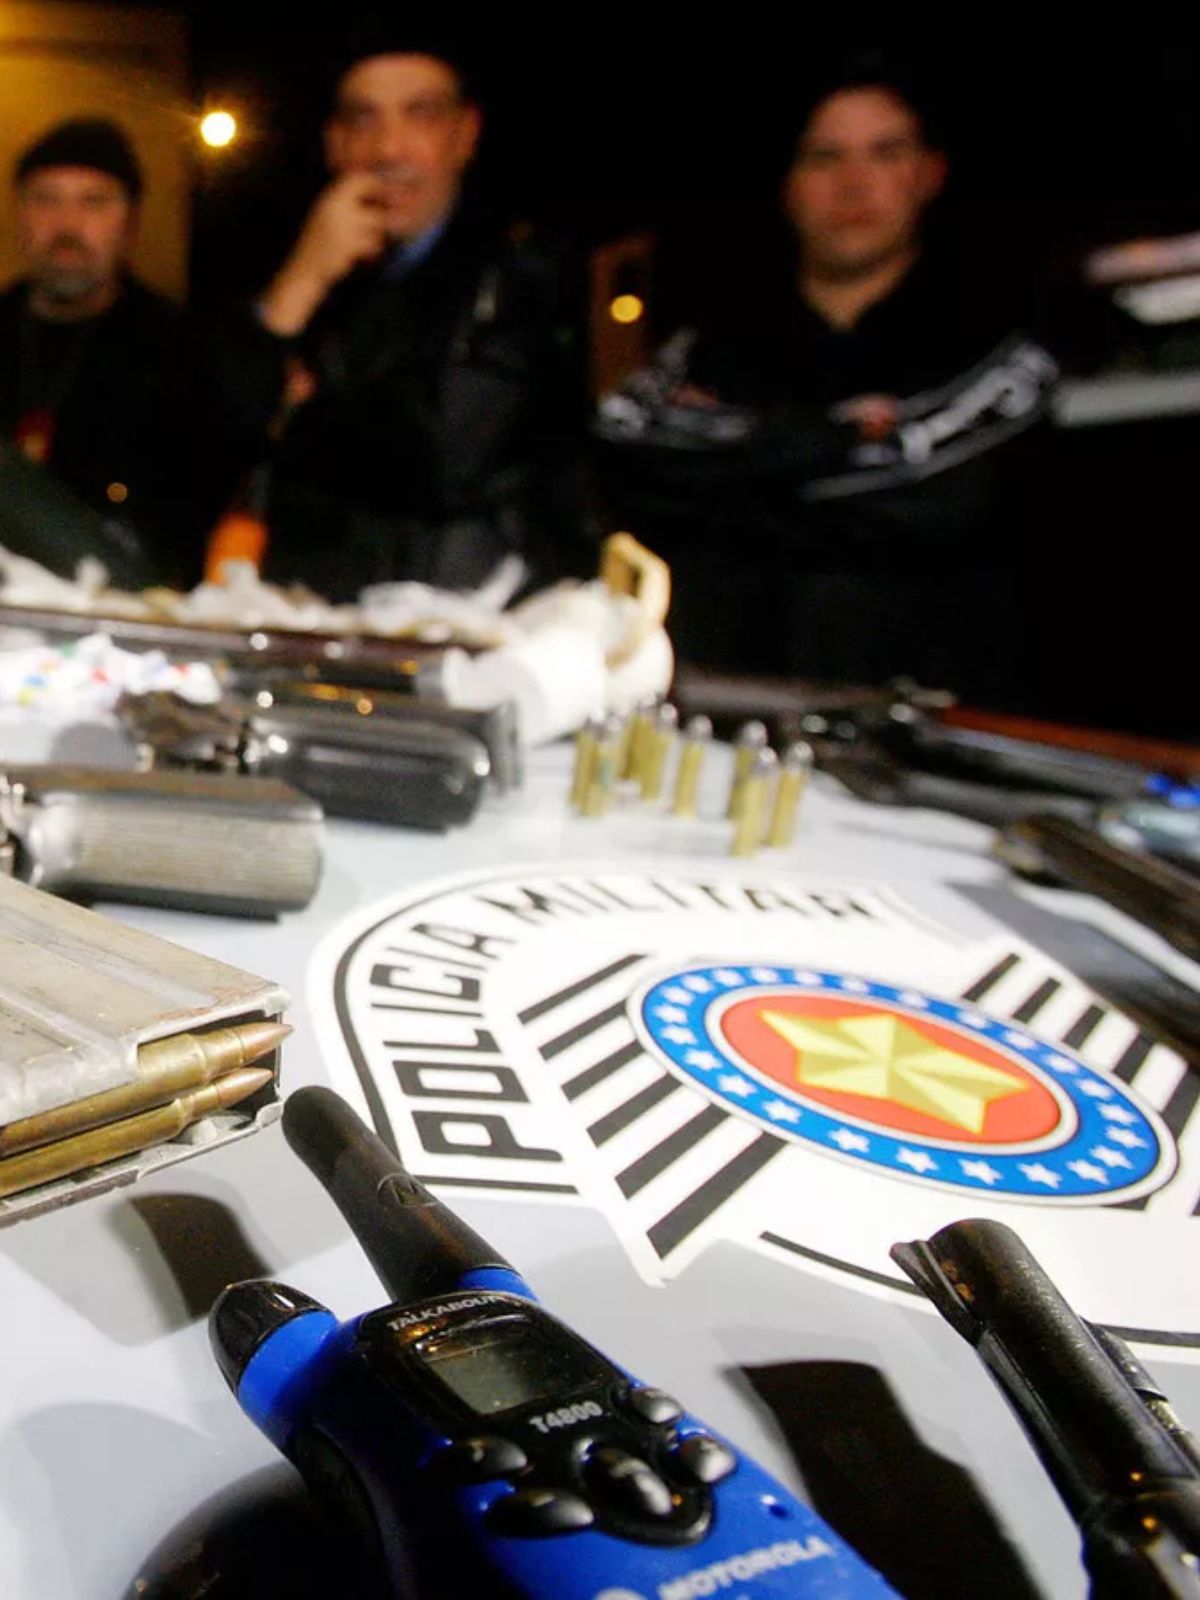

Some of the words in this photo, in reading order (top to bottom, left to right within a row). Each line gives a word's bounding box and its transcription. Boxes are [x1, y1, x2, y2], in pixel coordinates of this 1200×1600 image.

[369, 922, 564, 1162] POLICIA
[476, 877, 880, 926] MILITAR
[387, 1295, 503, 1332] TALKABOUT
[527, 1400, 603, 1434] T4800
[656, 1534, 834, 1600] MOTOROLA
